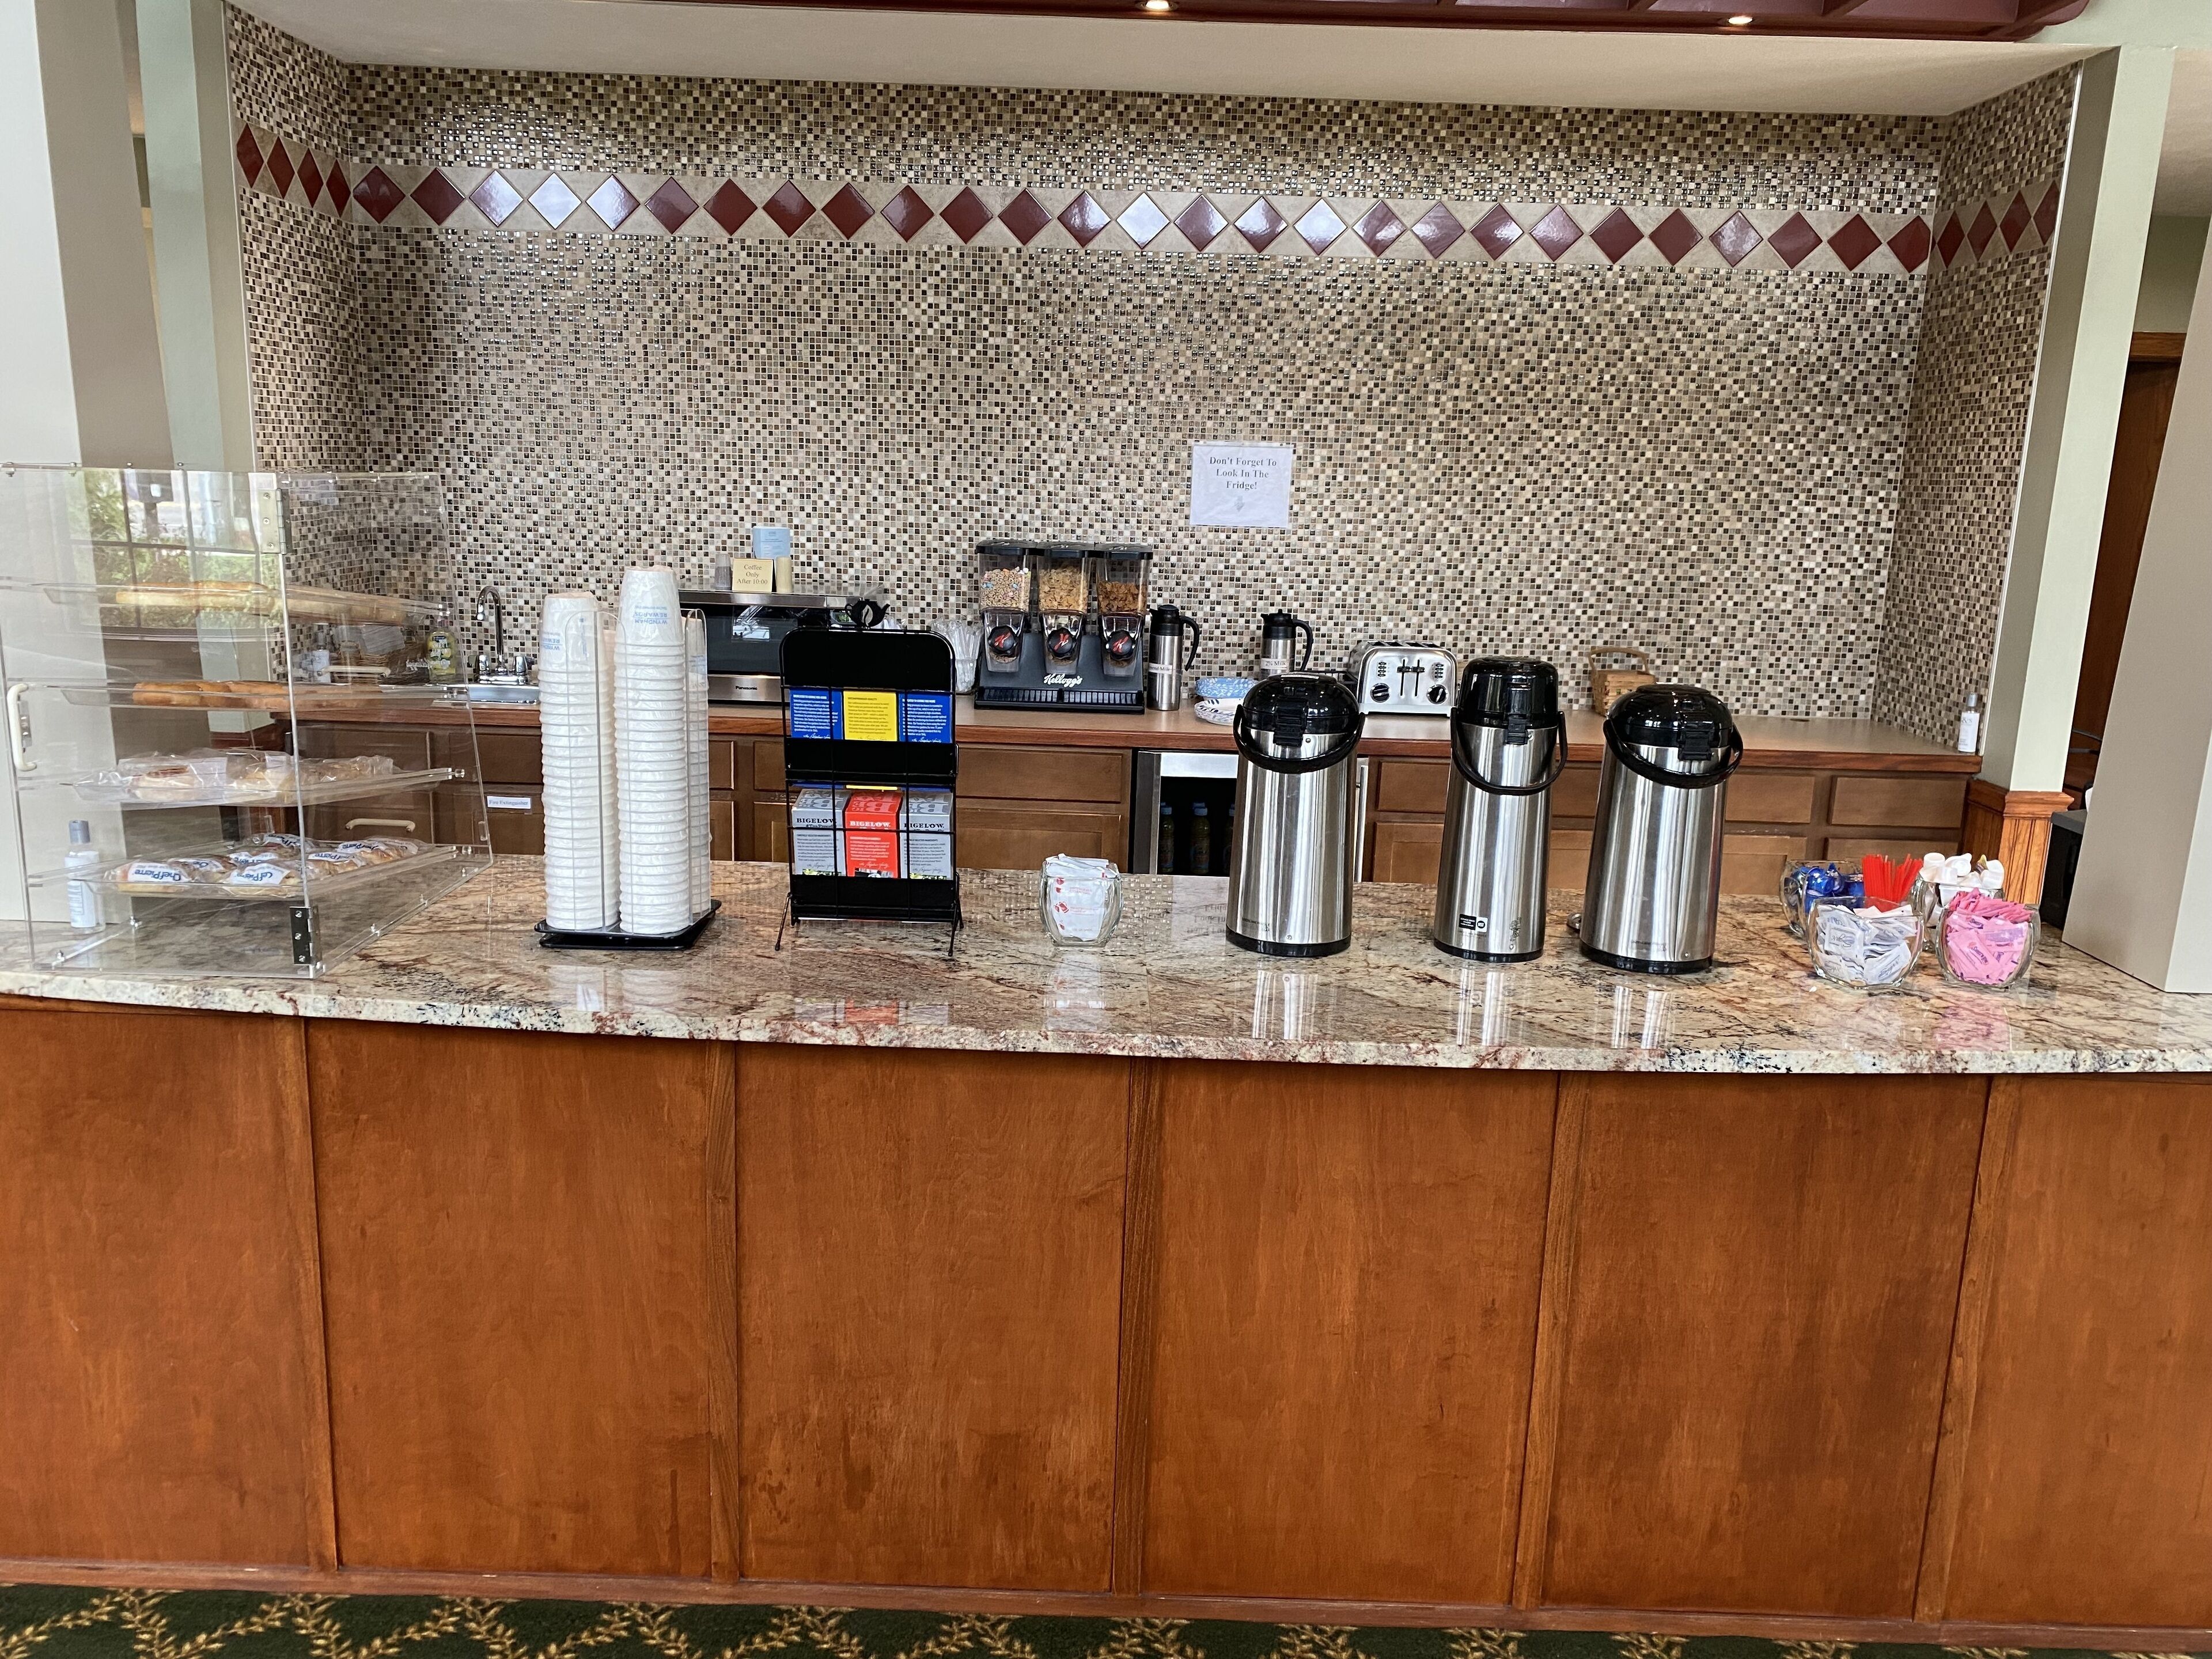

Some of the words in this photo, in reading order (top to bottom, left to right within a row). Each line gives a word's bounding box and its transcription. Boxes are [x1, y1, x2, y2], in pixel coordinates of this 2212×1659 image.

[1209, 456, 1232, 464] Don't
[1236, 457, 1263, 467] Forget
[1216, 468, 1238, 477] Look
[1241, 469, 1249, 477] In
[1253, 469, 1269, 478] The
[1226, 481, 1257, 491] Fridge!
[1043, 673, 1083, 687] Kellogg's
